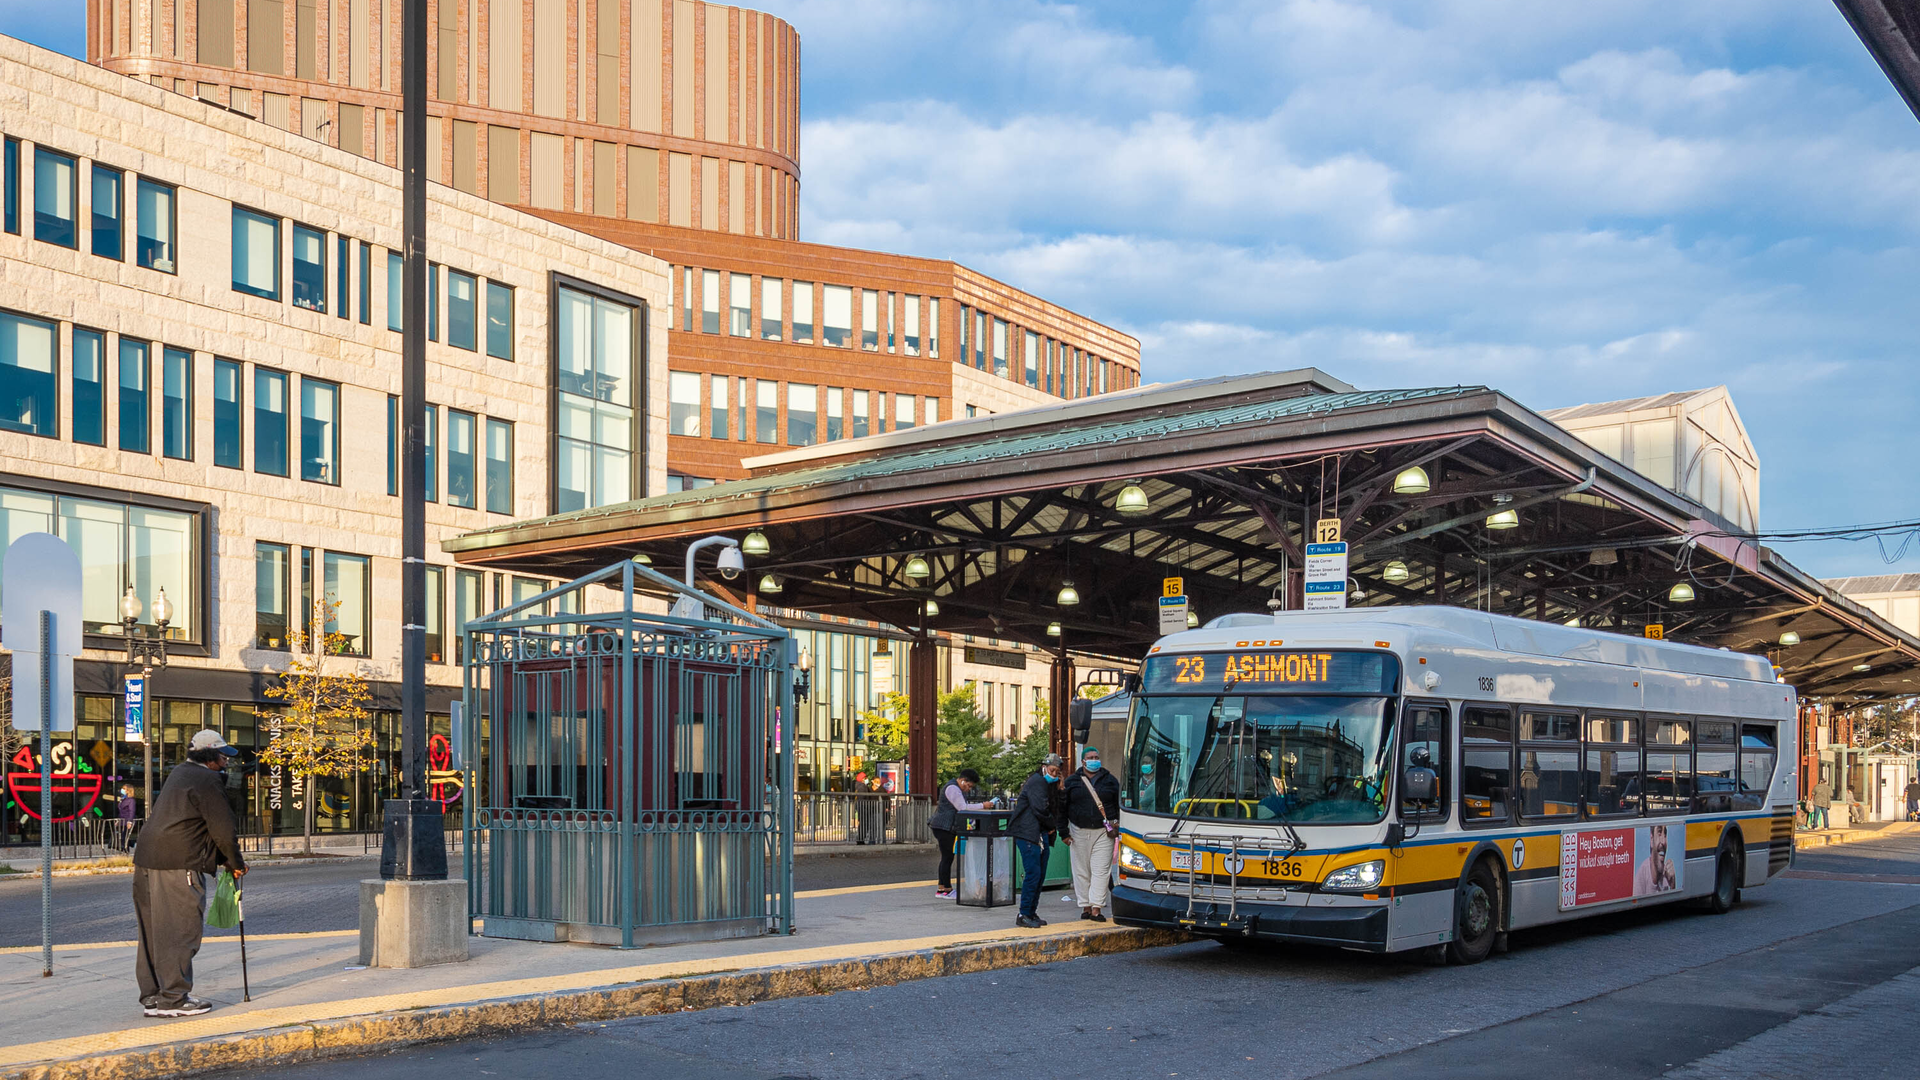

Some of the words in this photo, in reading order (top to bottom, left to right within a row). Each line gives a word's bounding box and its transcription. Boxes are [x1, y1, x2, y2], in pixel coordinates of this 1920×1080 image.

[1320, 528, 1338, 542] 12
[1166, 584, 1179, 594] 15
[1648, 630, 1660, 638] 13
[1175, 656, 1205, 683] 23
[1223, 654, 1332, 682] ASHMONT
[1478, 676, 1494, 691] 1836
[270, 765, 282, 810] SNACKS
[292, 767, 303, 797] TAKE
[292, 801, 303, 810] &
[1580, 837, 1591, 853] Hey
[1592, 836, 1613, 849] Boston,
[1614, 835, 1623, 850] get
[1616, 850, 1630, 864] teeth
[1261, 861, 1302, 877] 1836
